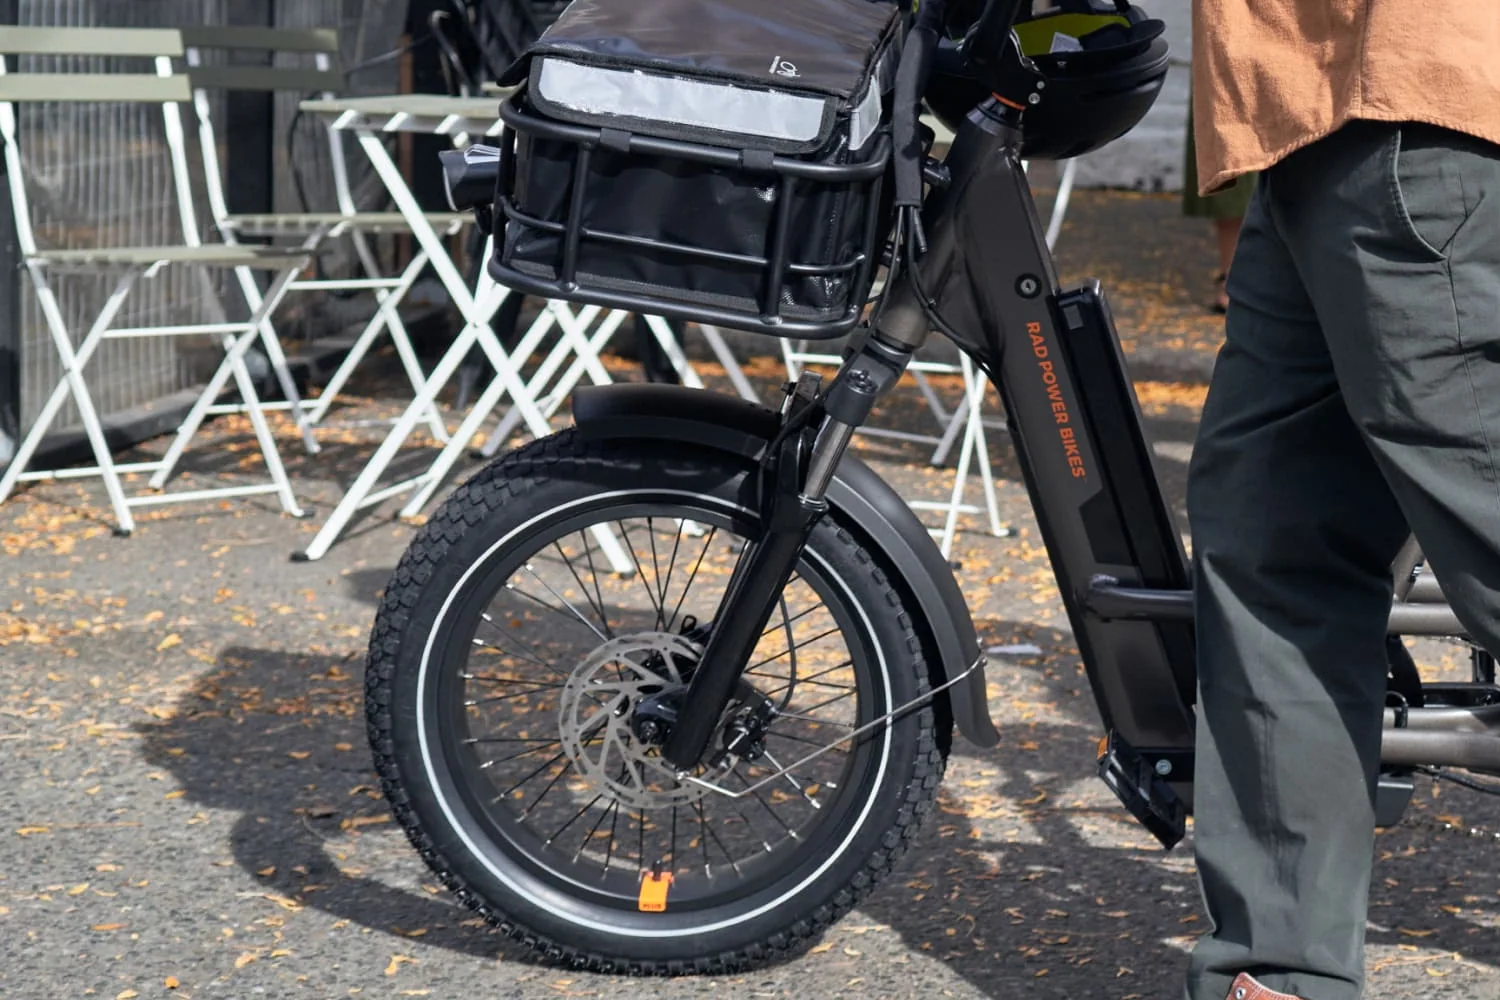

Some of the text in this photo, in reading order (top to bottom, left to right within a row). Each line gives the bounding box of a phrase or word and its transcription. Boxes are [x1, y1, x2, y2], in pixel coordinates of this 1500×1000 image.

[1025, 321, 1086, 479] RAD POWER BIKES
